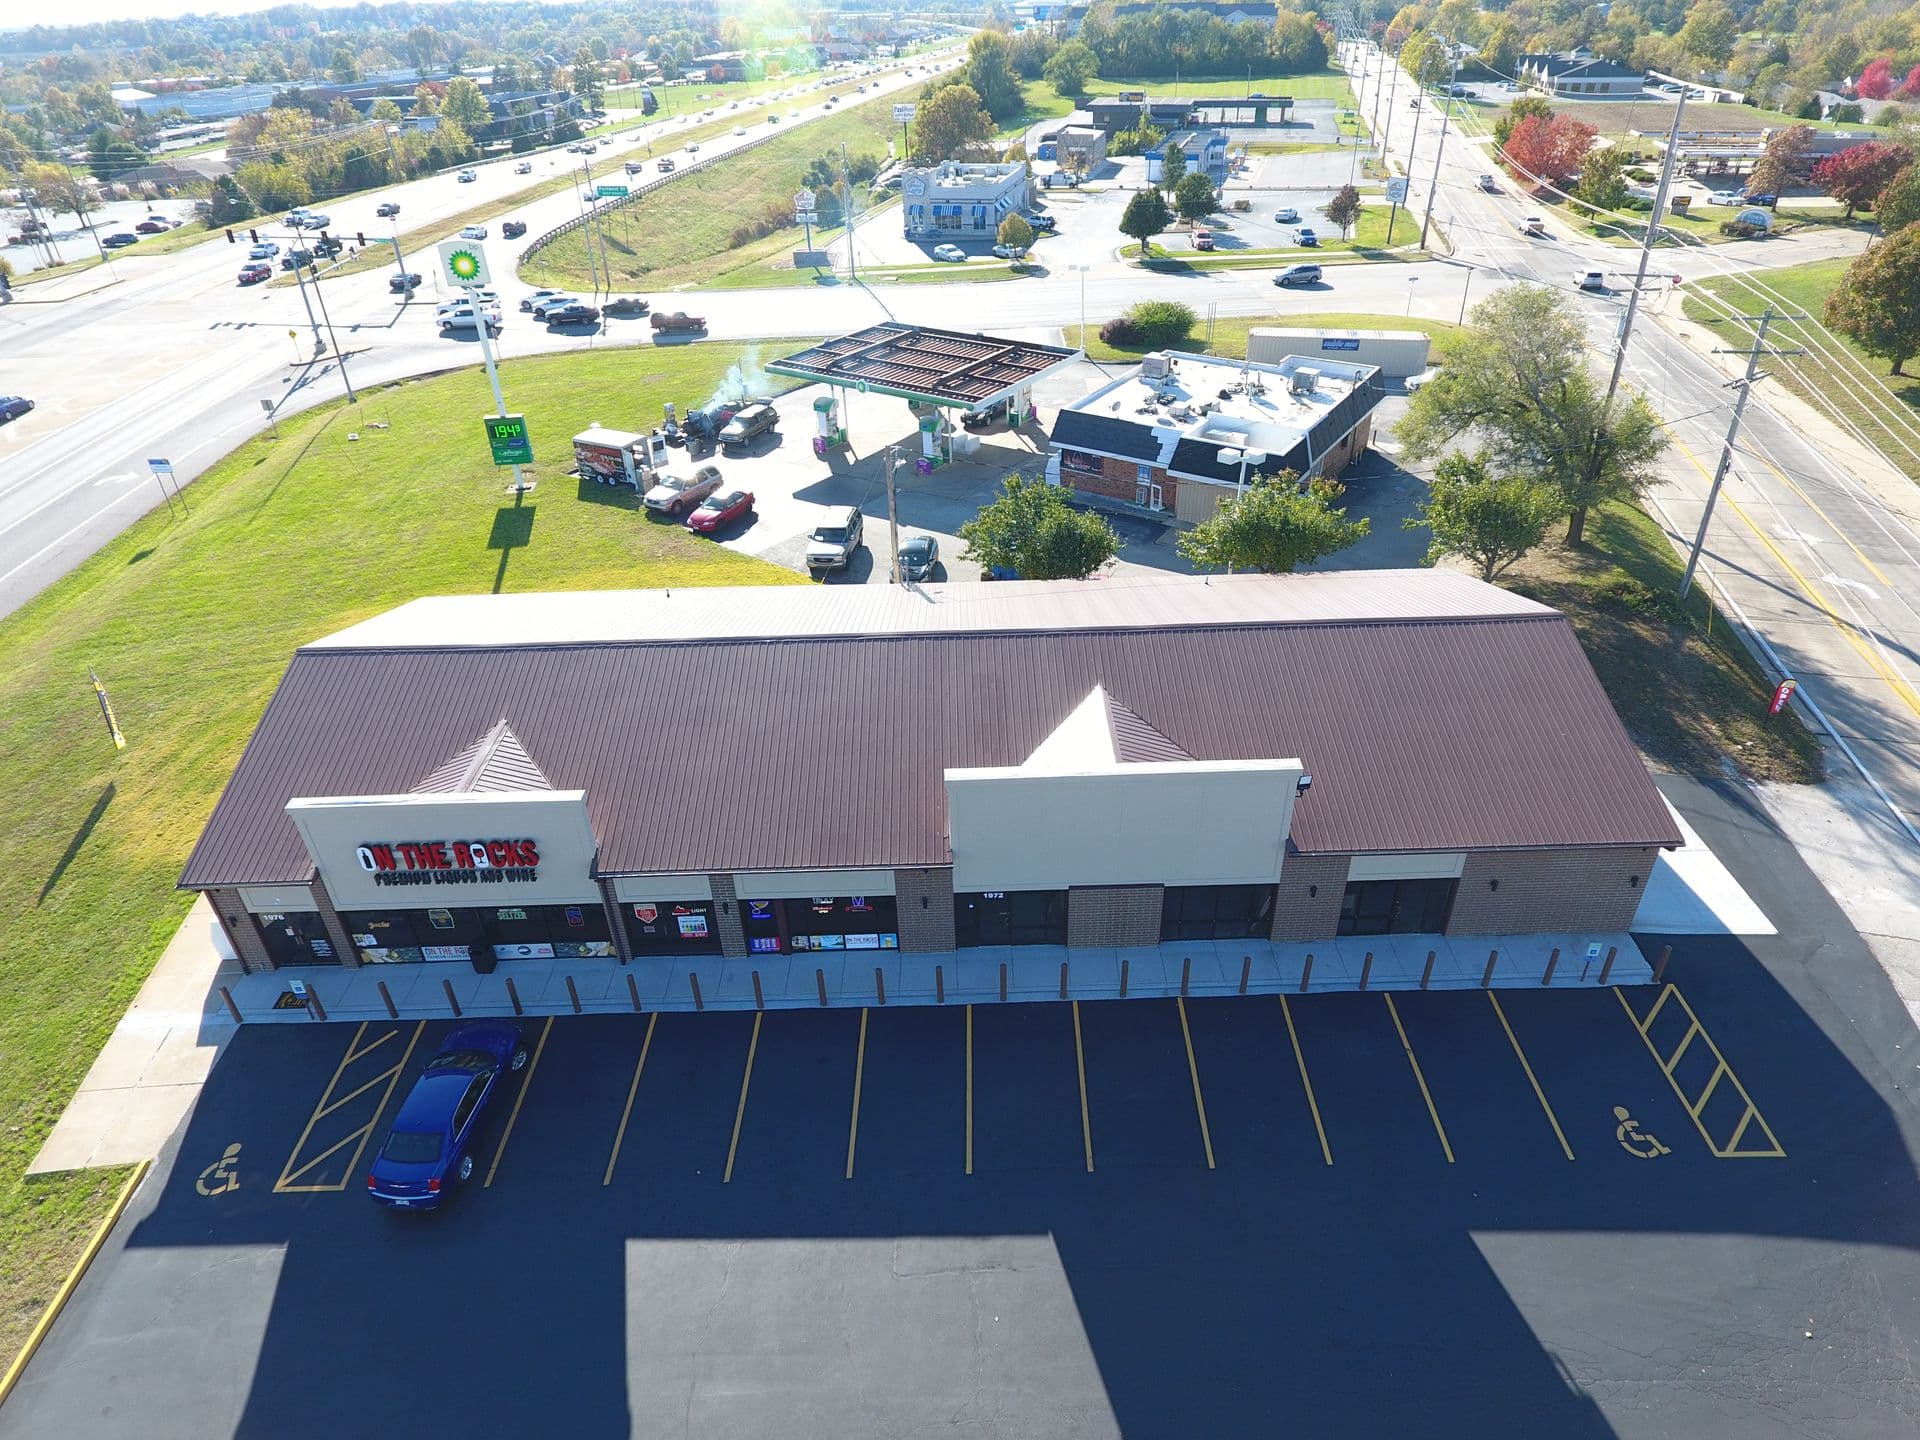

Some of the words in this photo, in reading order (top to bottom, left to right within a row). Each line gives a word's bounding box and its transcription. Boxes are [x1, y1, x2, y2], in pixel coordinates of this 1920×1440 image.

[1774, 687, 1790, 713] OPEN
[356, 845, 397, 872] ON
[397, 842, 452, 870] THE
[453, 840, 540, 868] ROCKS
[374, 871, 432, 886] PREMIUM
[433, 870, 478, 885] LIQUOR
[480, 869, 504, 883] AND
[505, 868, 538, 883] WINE
[496, 911, 528, 920] SELTZER
